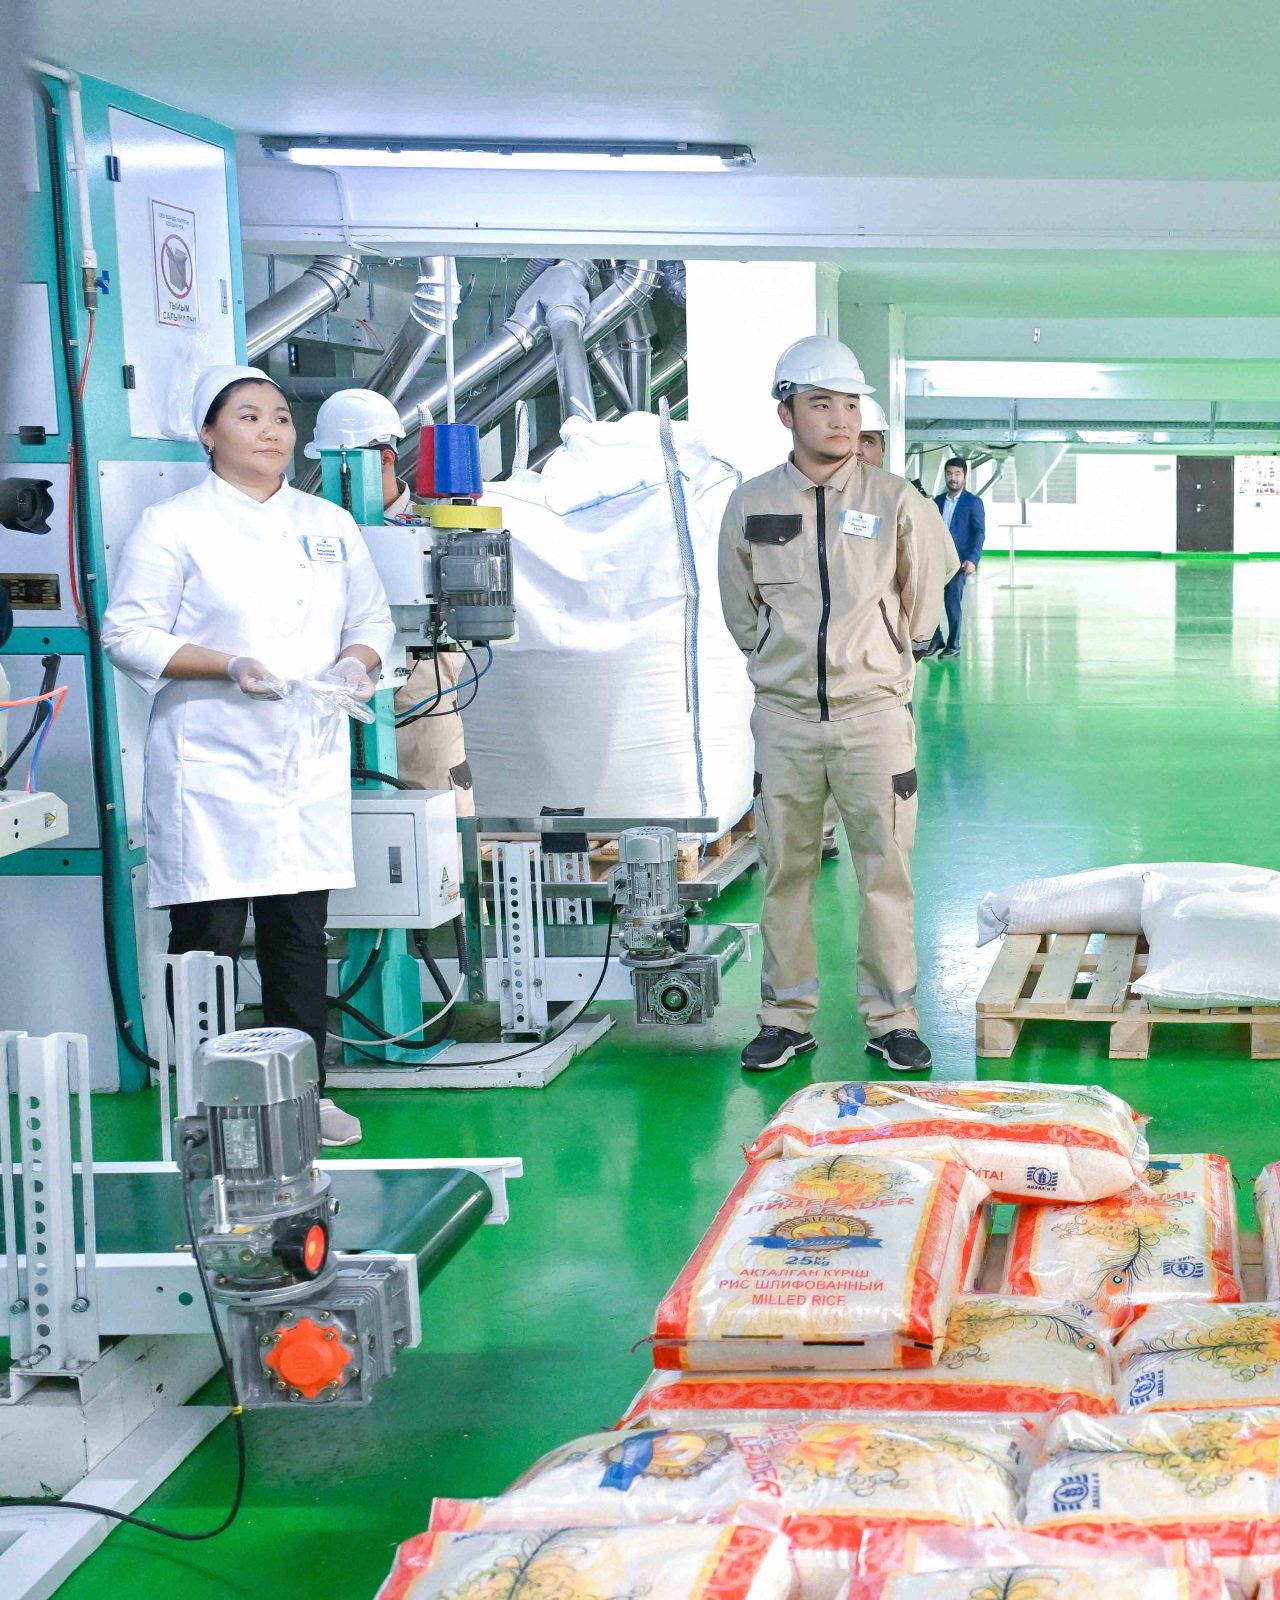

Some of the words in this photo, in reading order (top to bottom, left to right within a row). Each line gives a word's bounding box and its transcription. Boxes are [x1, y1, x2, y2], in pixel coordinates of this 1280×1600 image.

[804, 1197, 915, 1216] LEADER
[785, 1256, 812, 1265] 25
[719, 1280, 750, 1289] РИС
[755, 1280, 883, 1291] ШЛИФОВАННЫЙ
[752, 1294, 806, 1305] MILLED
[811, 1295, 846, 1306] RICE
[734, 1435, 783, 1498] LEADER
